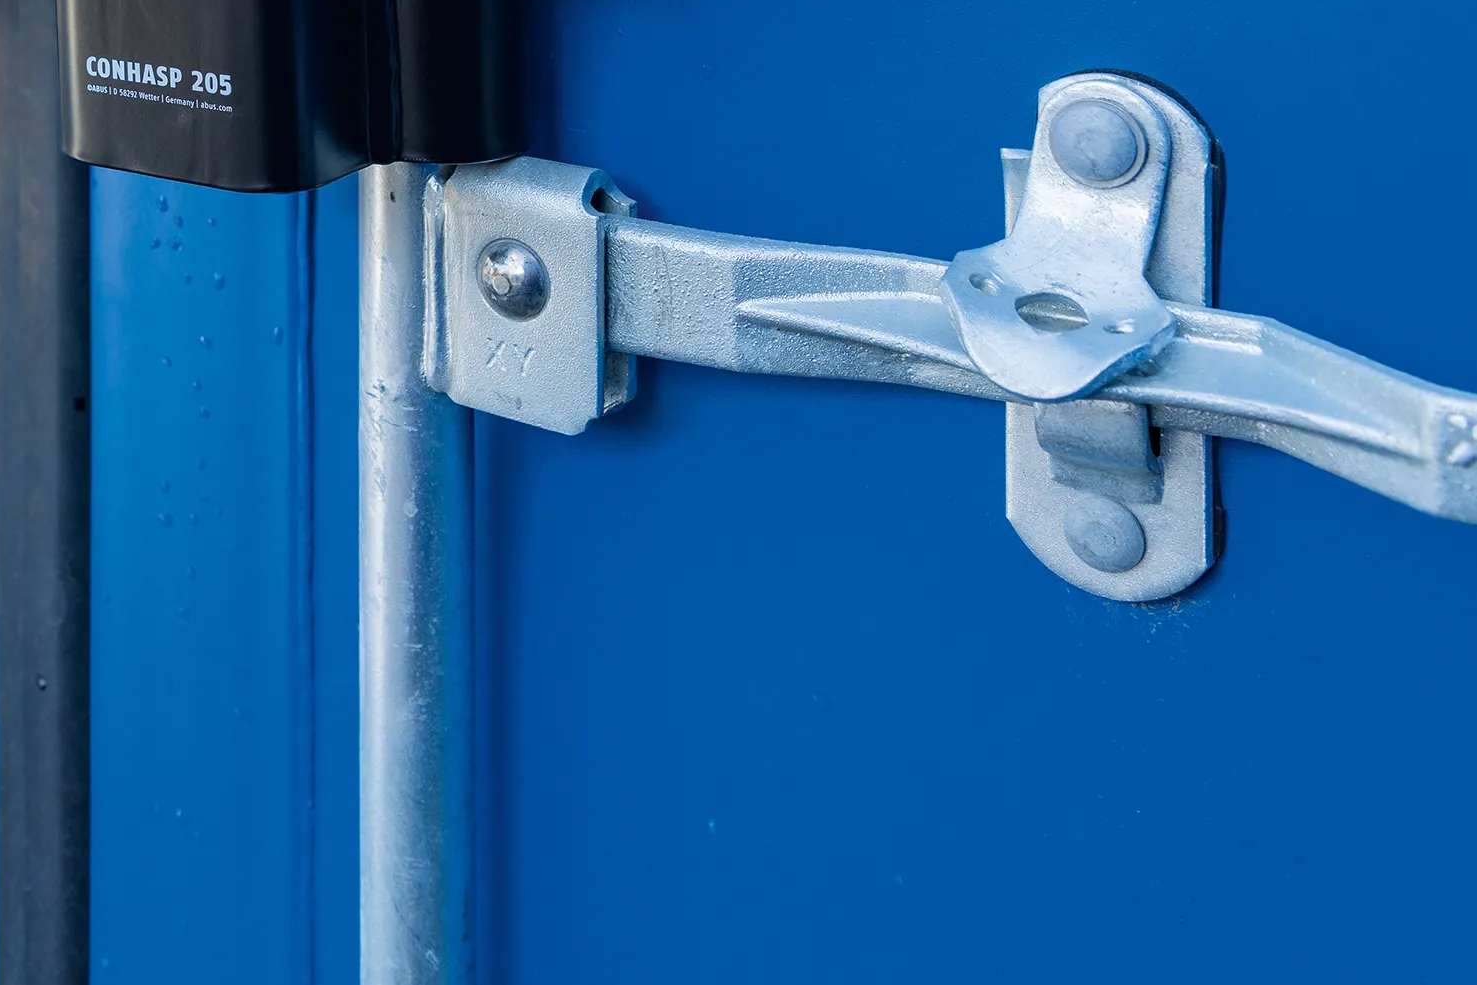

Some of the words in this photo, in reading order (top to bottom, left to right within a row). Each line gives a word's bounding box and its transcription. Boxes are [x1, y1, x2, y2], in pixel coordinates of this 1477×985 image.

[86, 55, 183, 89] CONHASP
[191, 70, 233, 96] 205
[119, 89, 138, 99] 58292
[138, 91, 160, 102] Wetter
[166, 96, 194, 109] Germany
[200, 101, 233, 113] abus.com
